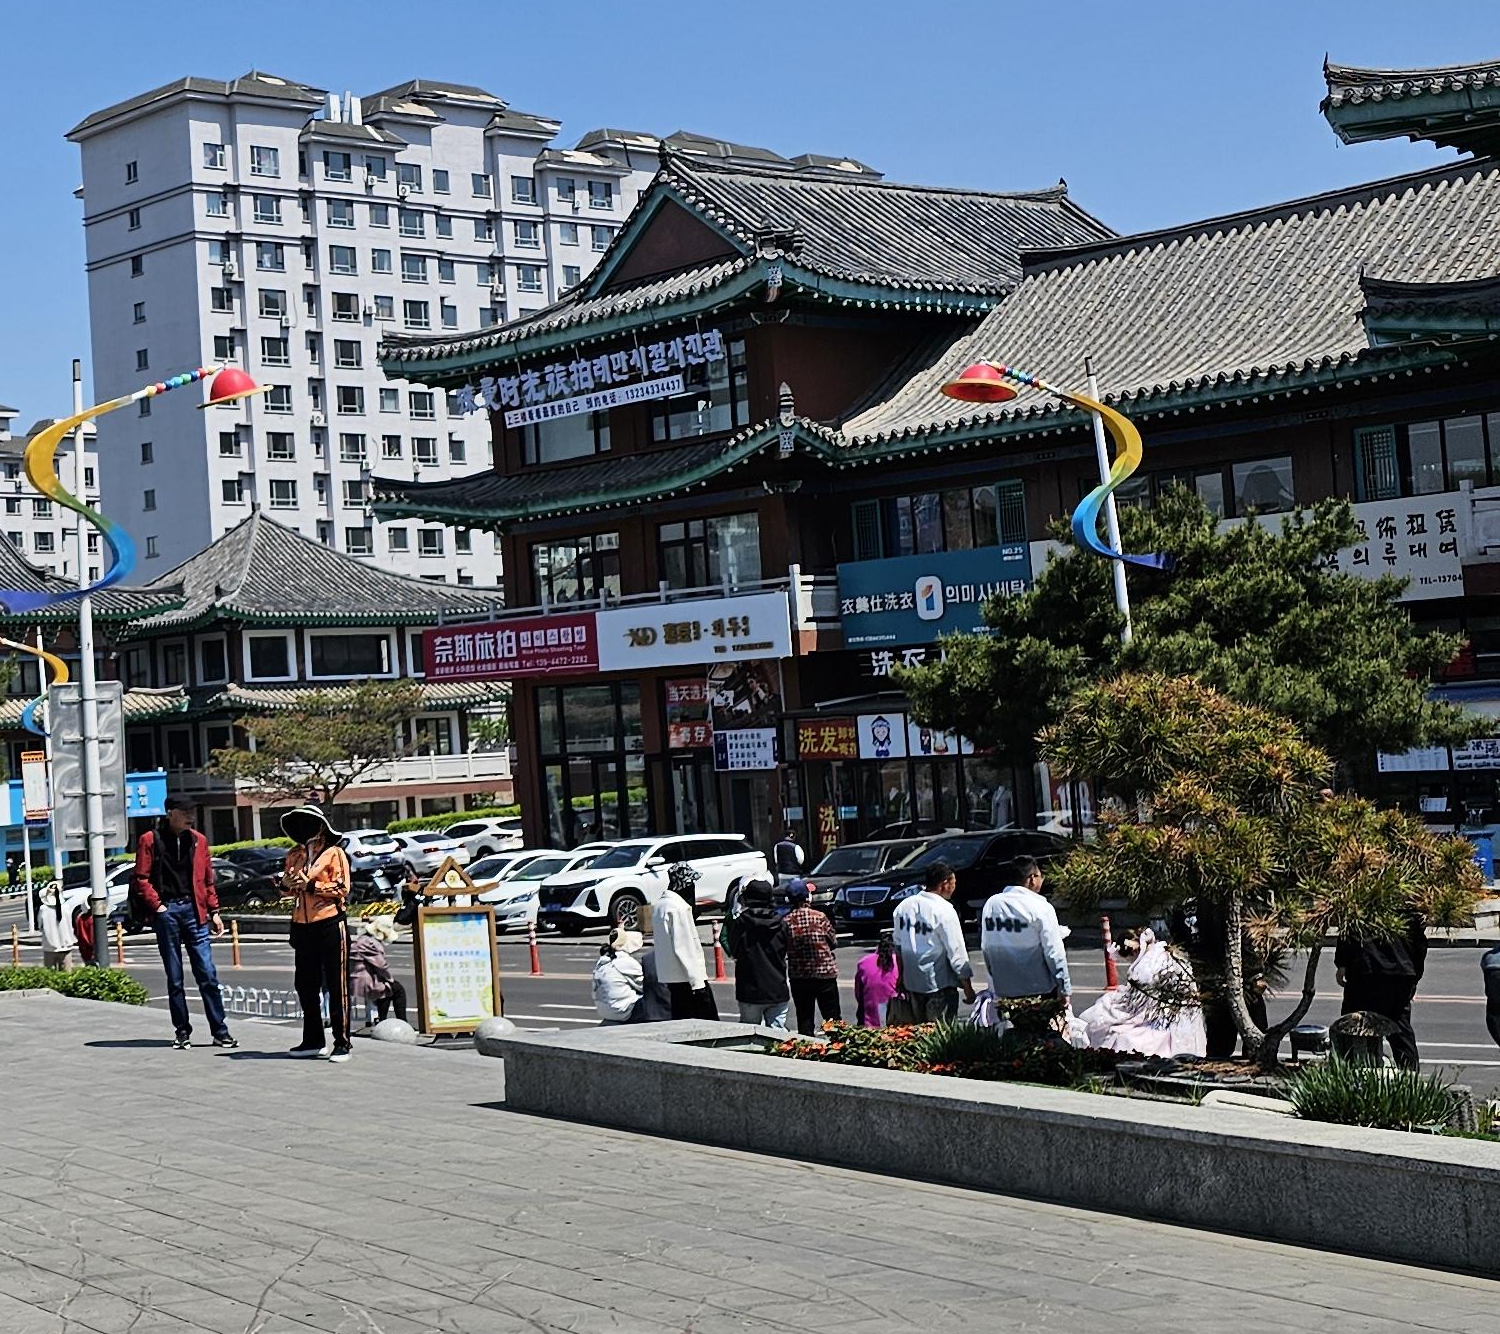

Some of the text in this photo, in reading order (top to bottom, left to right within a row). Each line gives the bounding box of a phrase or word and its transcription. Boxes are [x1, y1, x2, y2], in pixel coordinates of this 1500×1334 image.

[434, 630, 518, 664] 奈斯旅拍
[799, 727, 839, 753] 洗发
